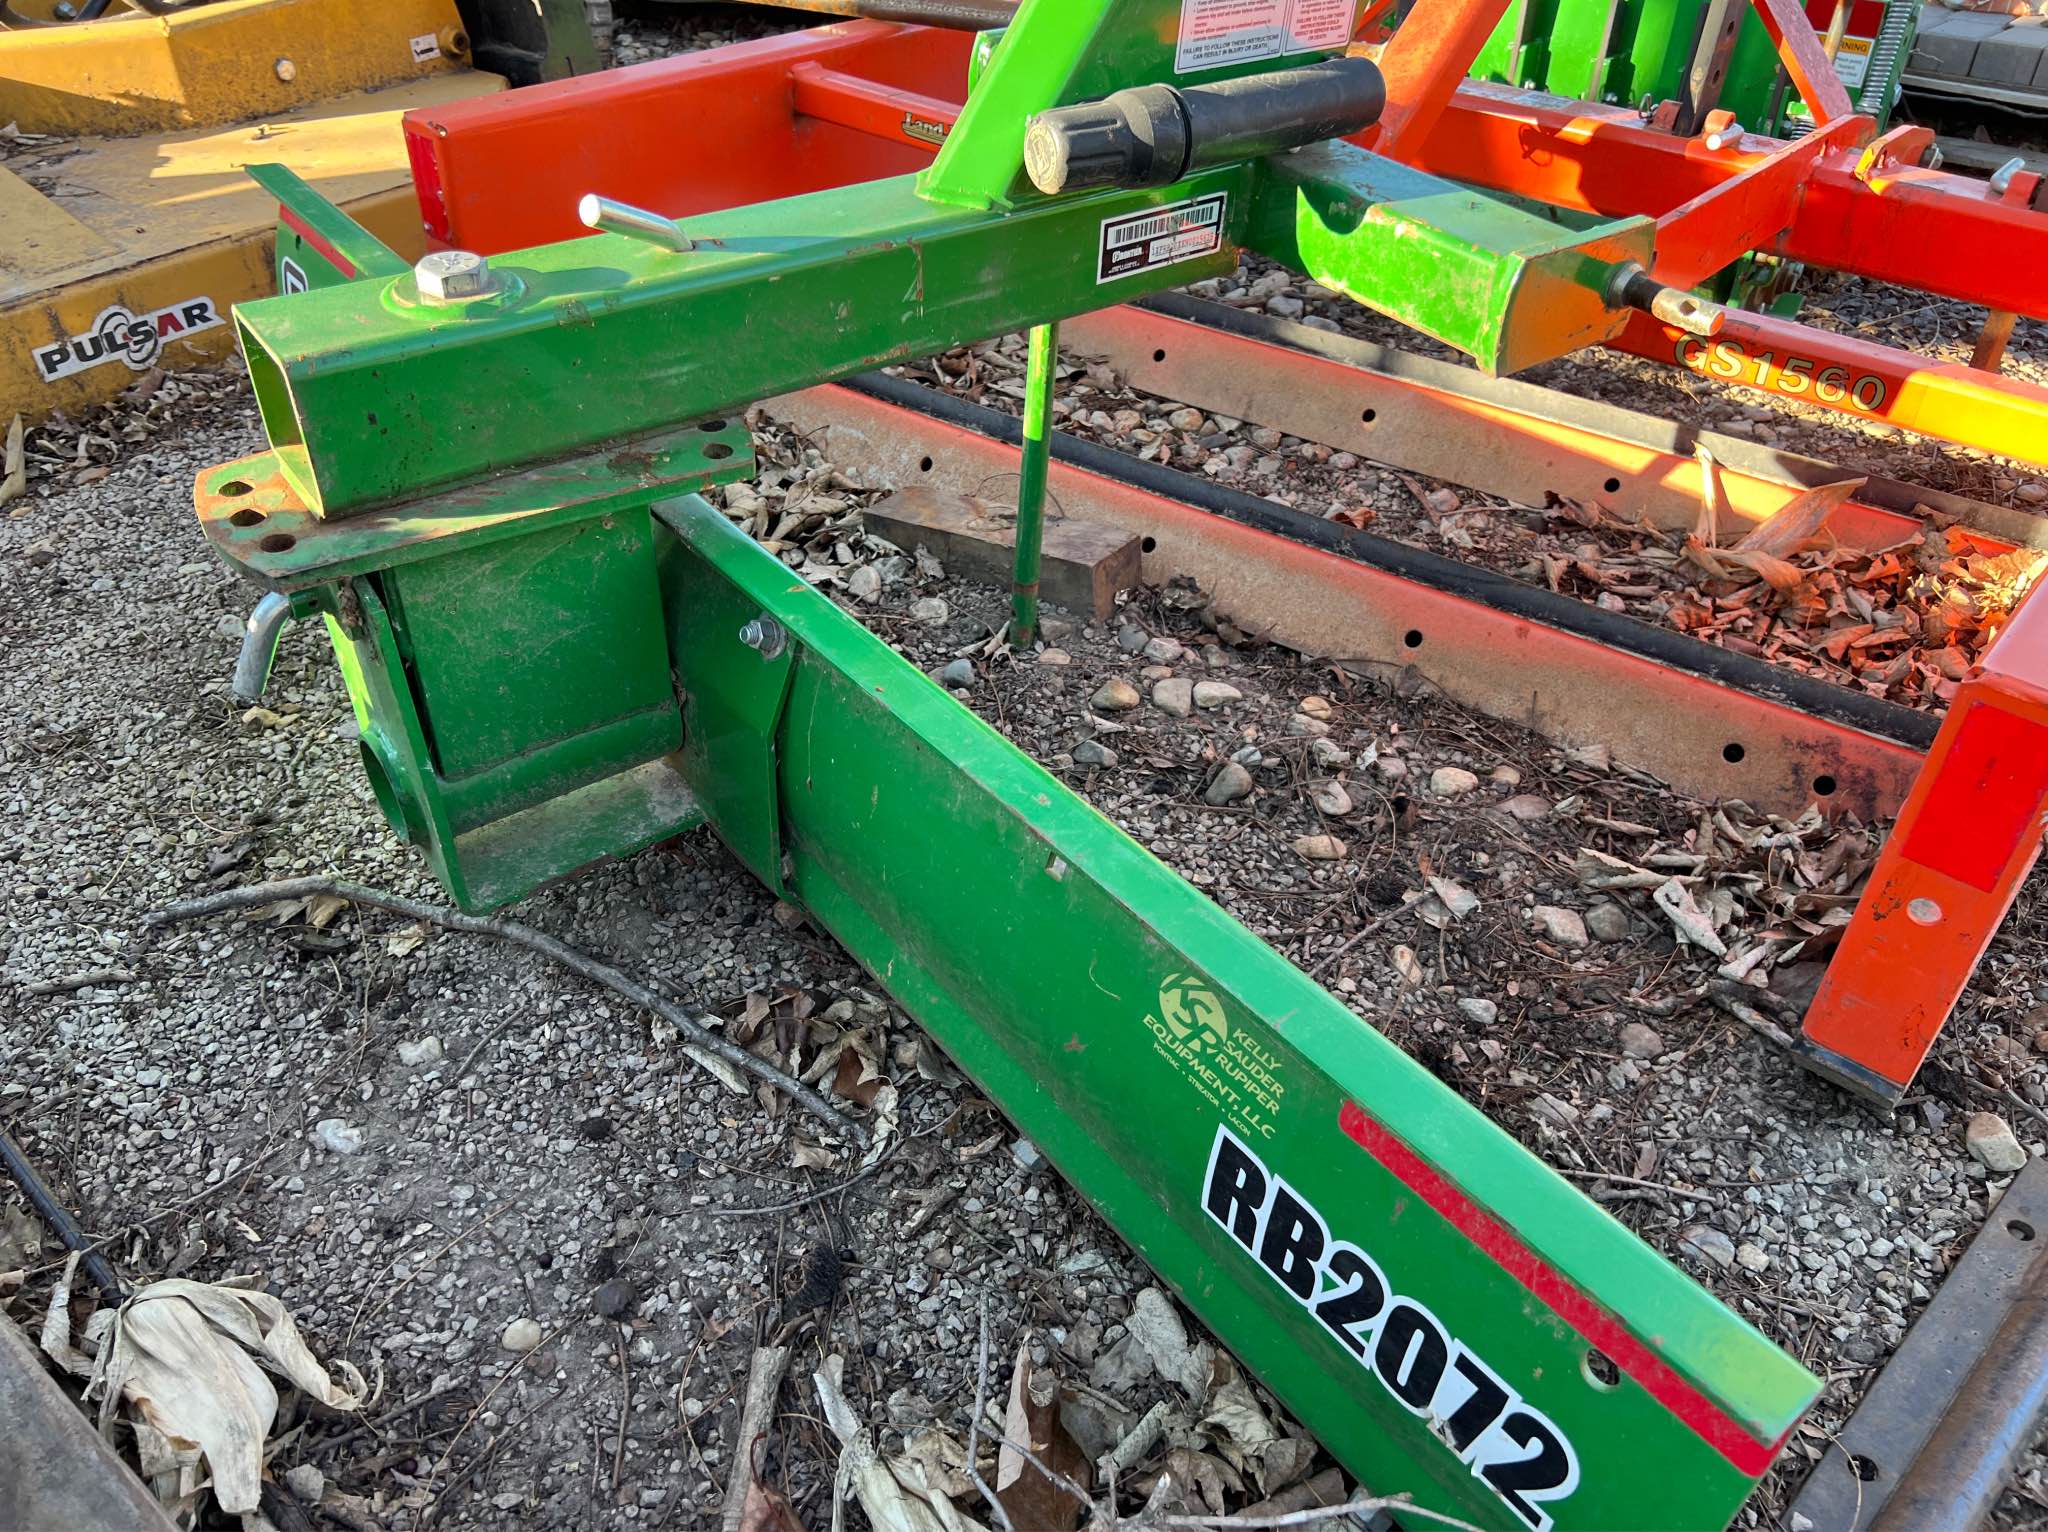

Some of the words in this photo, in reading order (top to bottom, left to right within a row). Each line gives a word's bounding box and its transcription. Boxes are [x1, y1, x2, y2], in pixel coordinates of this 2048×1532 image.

[1211, 41, 1231, 50] FOLLOW
[903, 111, 944, 138] Land
[39, 301, 214, 375] PULSAR
[1674, 331, 1887, 412] GS1560
[1142, 1013, 1241, 1111] EQUIPMENT,
[1241, 1105, 1276, 1139] LLC
[1223, 1040, 1284, 1099] SAUDER
[1233, 1028, 1283, 1071] KELLY
[1153, 1042, 1180, 1070] PONTIAC
[1187, 1074, 1220, 1107] STREATOR
[1227, 1112, 1251, 1137] LACON
[1215, 1053, 1280, 1116] RUPIPER
[1203, 1128, 1576, 1531] RB2072
